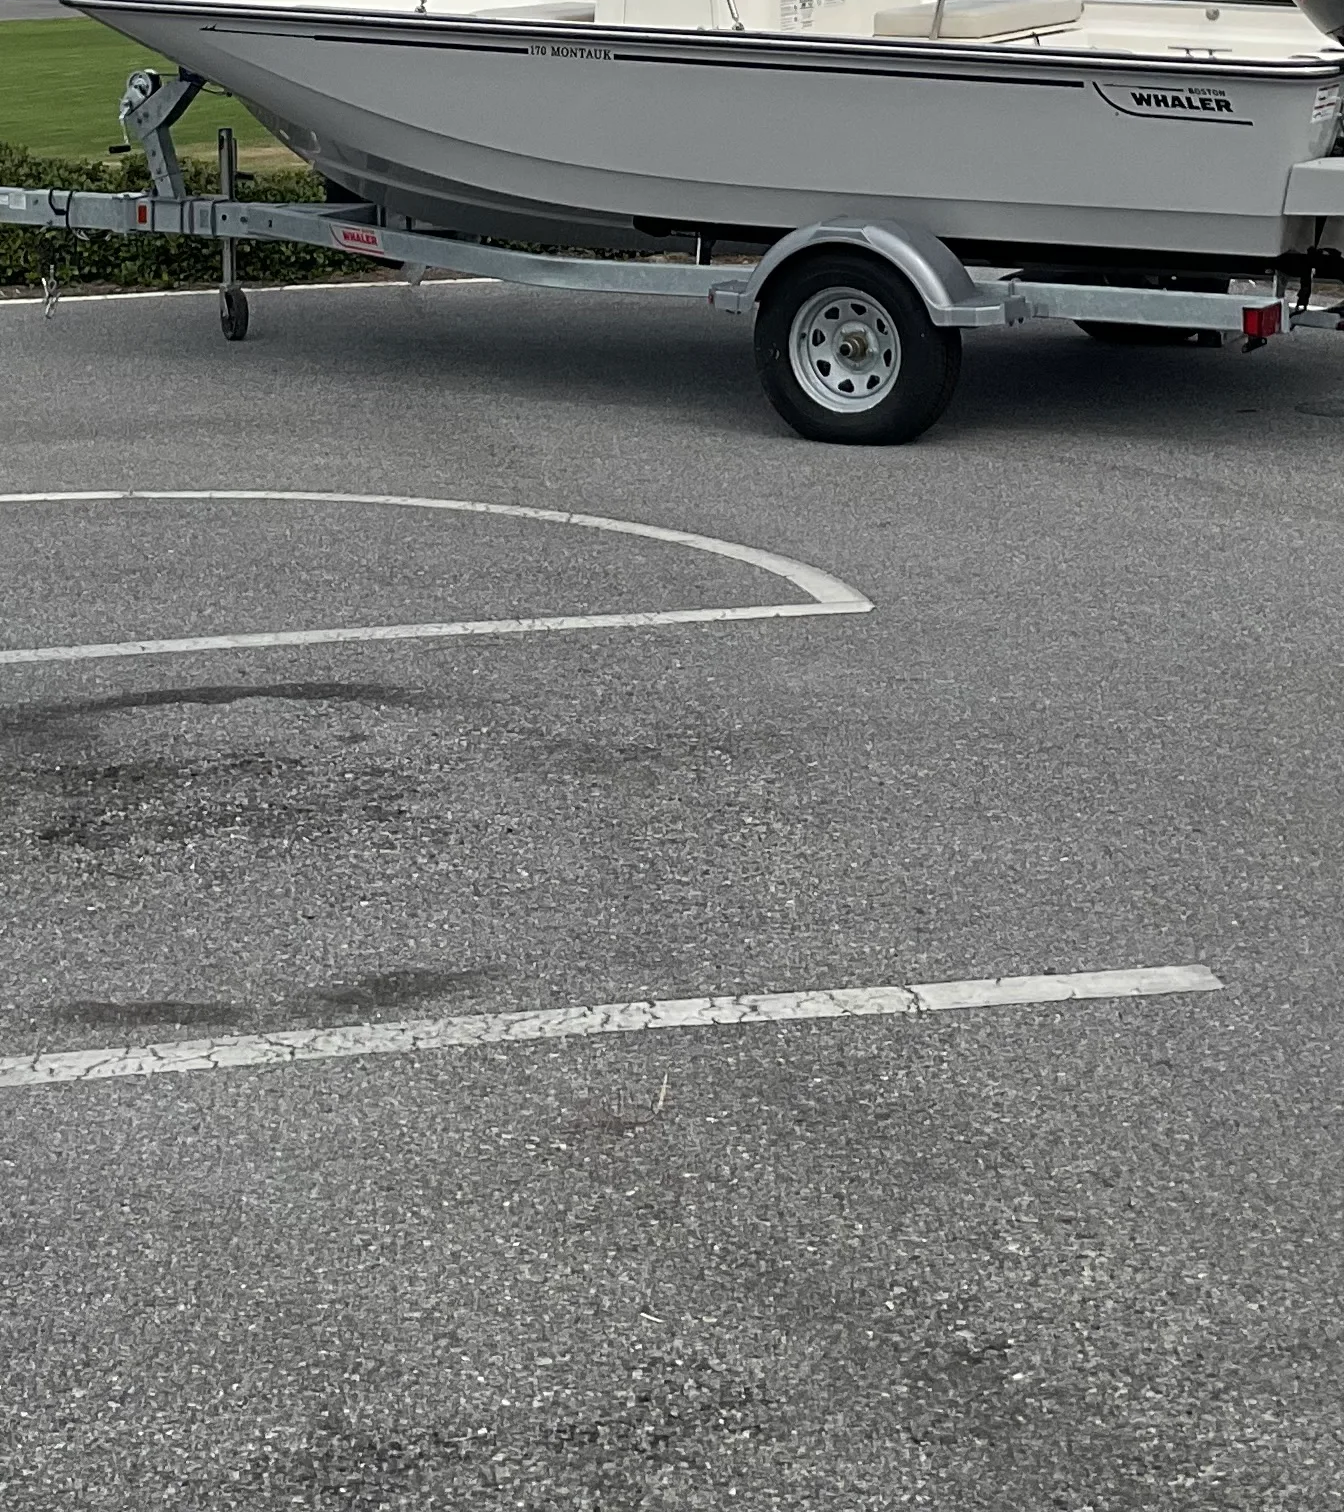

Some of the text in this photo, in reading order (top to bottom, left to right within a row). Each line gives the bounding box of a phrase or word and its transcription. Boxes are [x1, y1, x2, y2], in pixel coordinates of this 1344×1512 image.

[530, 44, 612, 61] 170 MONTAUK
[1187, 87, 1226, 97] BOSTON
[1130, 91, 1234, 113] WHALER
[342, 230, 379, 246] WHALER
